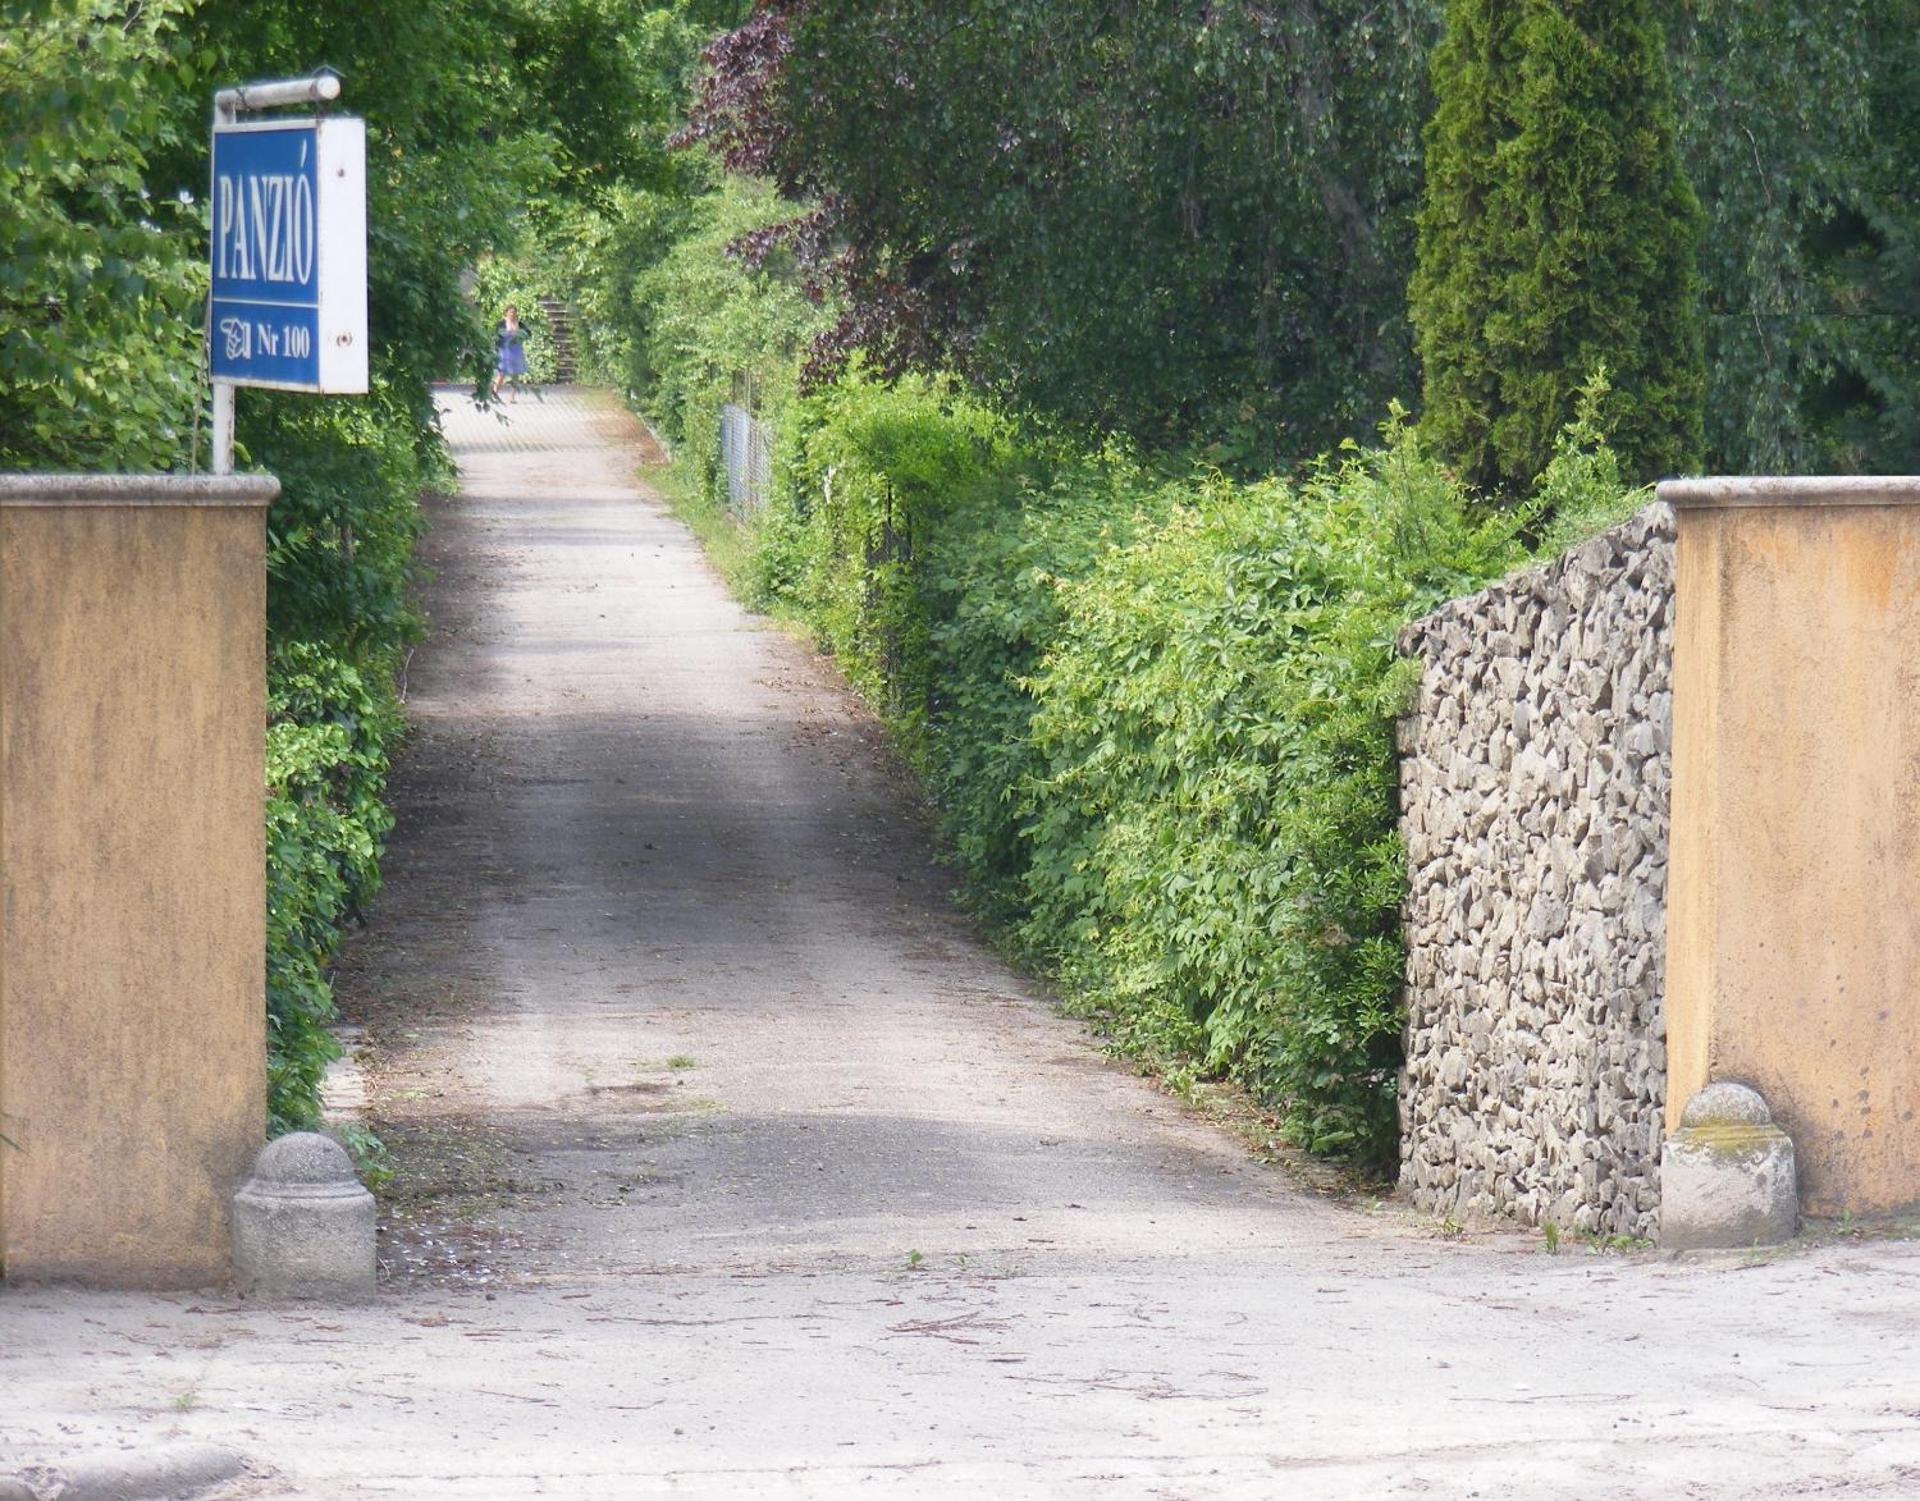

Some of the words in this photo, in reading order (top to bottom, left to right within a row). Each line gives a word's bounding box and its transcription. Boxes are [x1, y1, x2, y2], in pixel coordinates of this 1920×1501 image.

[218, 138, 313, 285] PANZIÓ
[257, 323, 278, 356] Nr
[283, 325, 310, 359] 100
